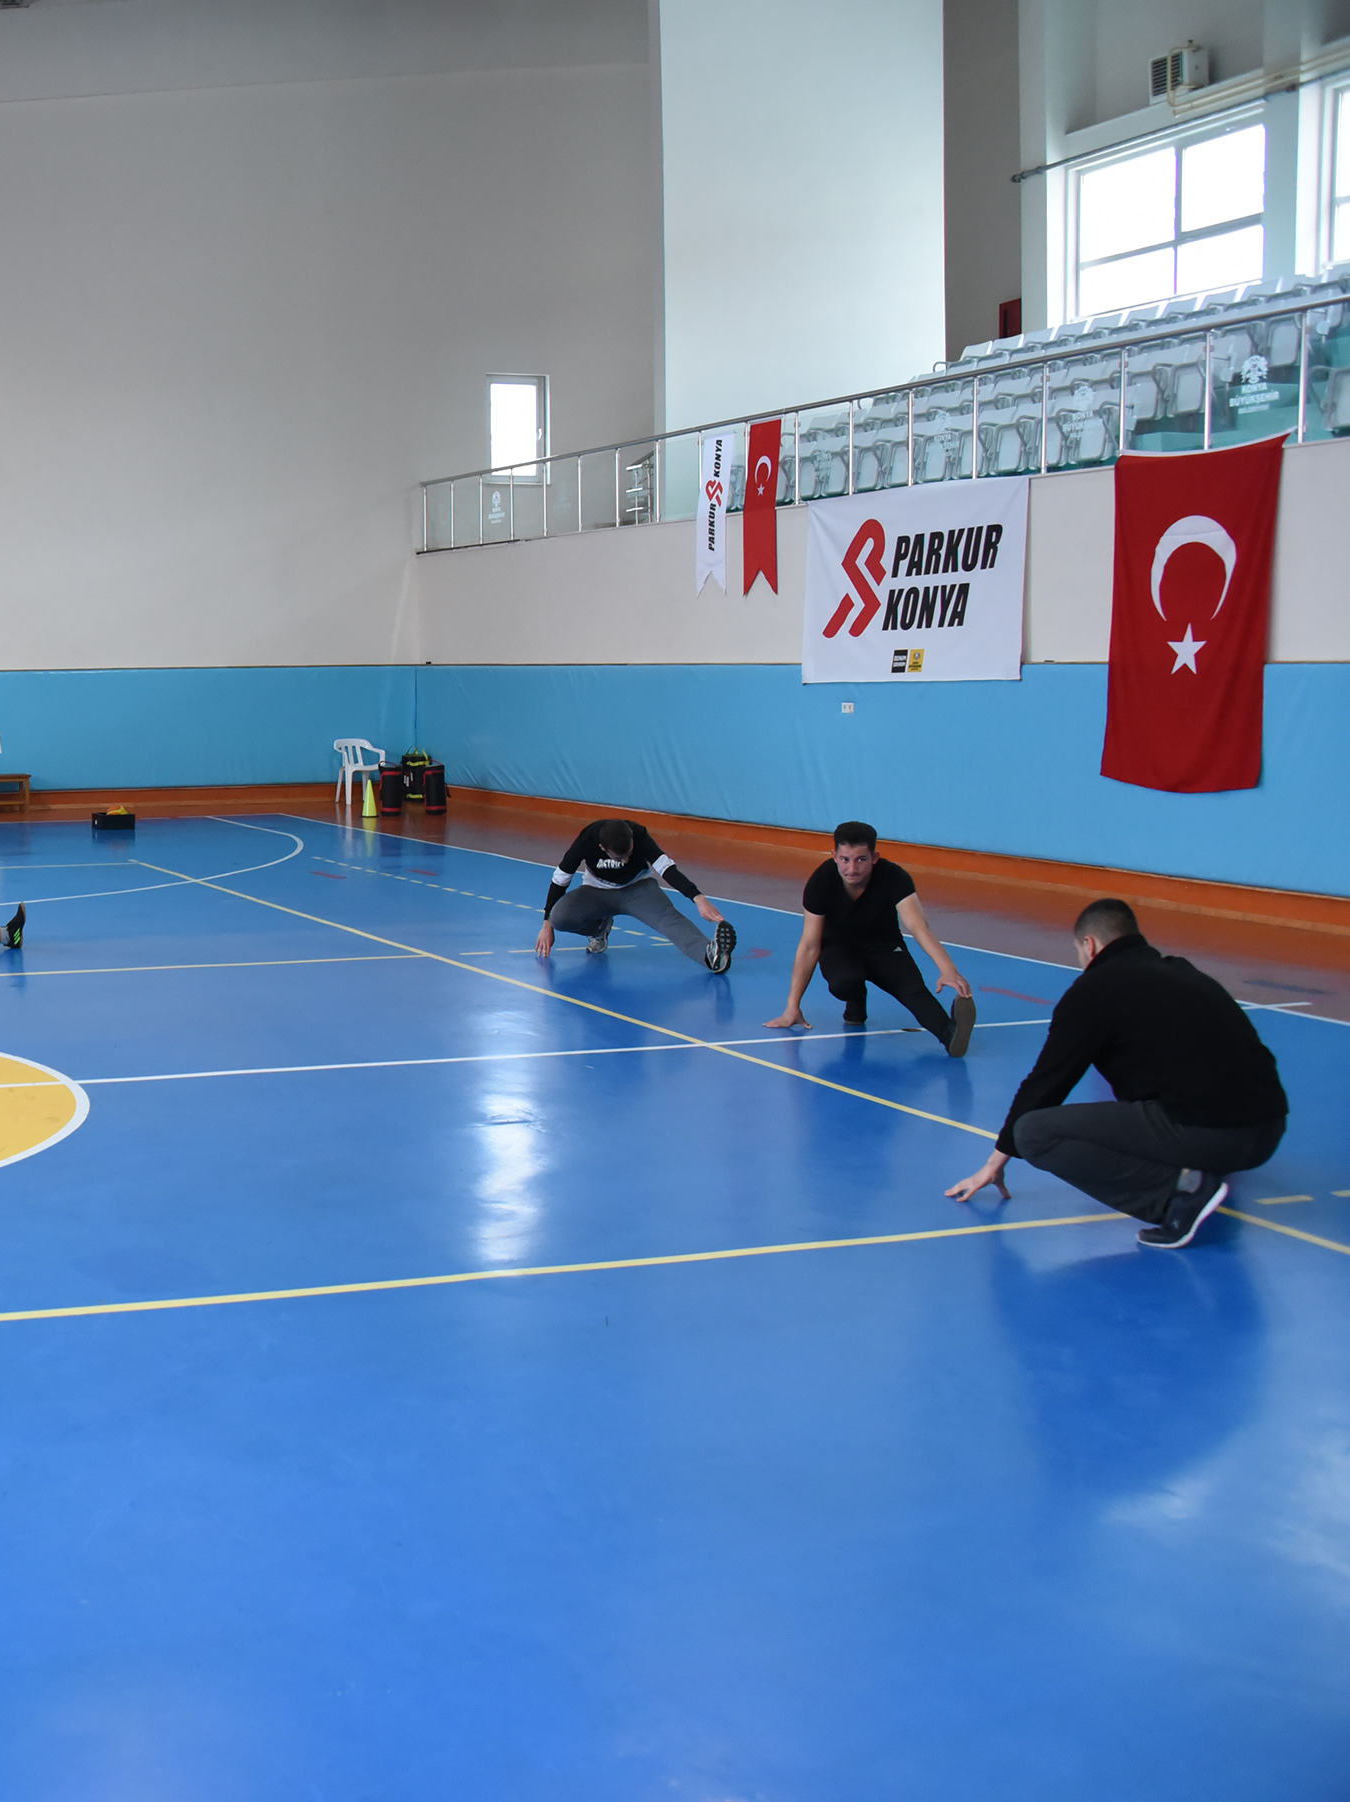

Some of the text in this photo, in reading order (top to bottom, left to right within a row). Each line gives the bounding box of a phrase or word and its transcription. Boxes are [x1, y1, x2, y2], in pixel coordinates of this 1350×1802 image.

[708, 439, 723, 551] PARKUR KONYA
[891, 524, 1004, 578] PARKUR
[881, 582, 970, 631] KONYA
